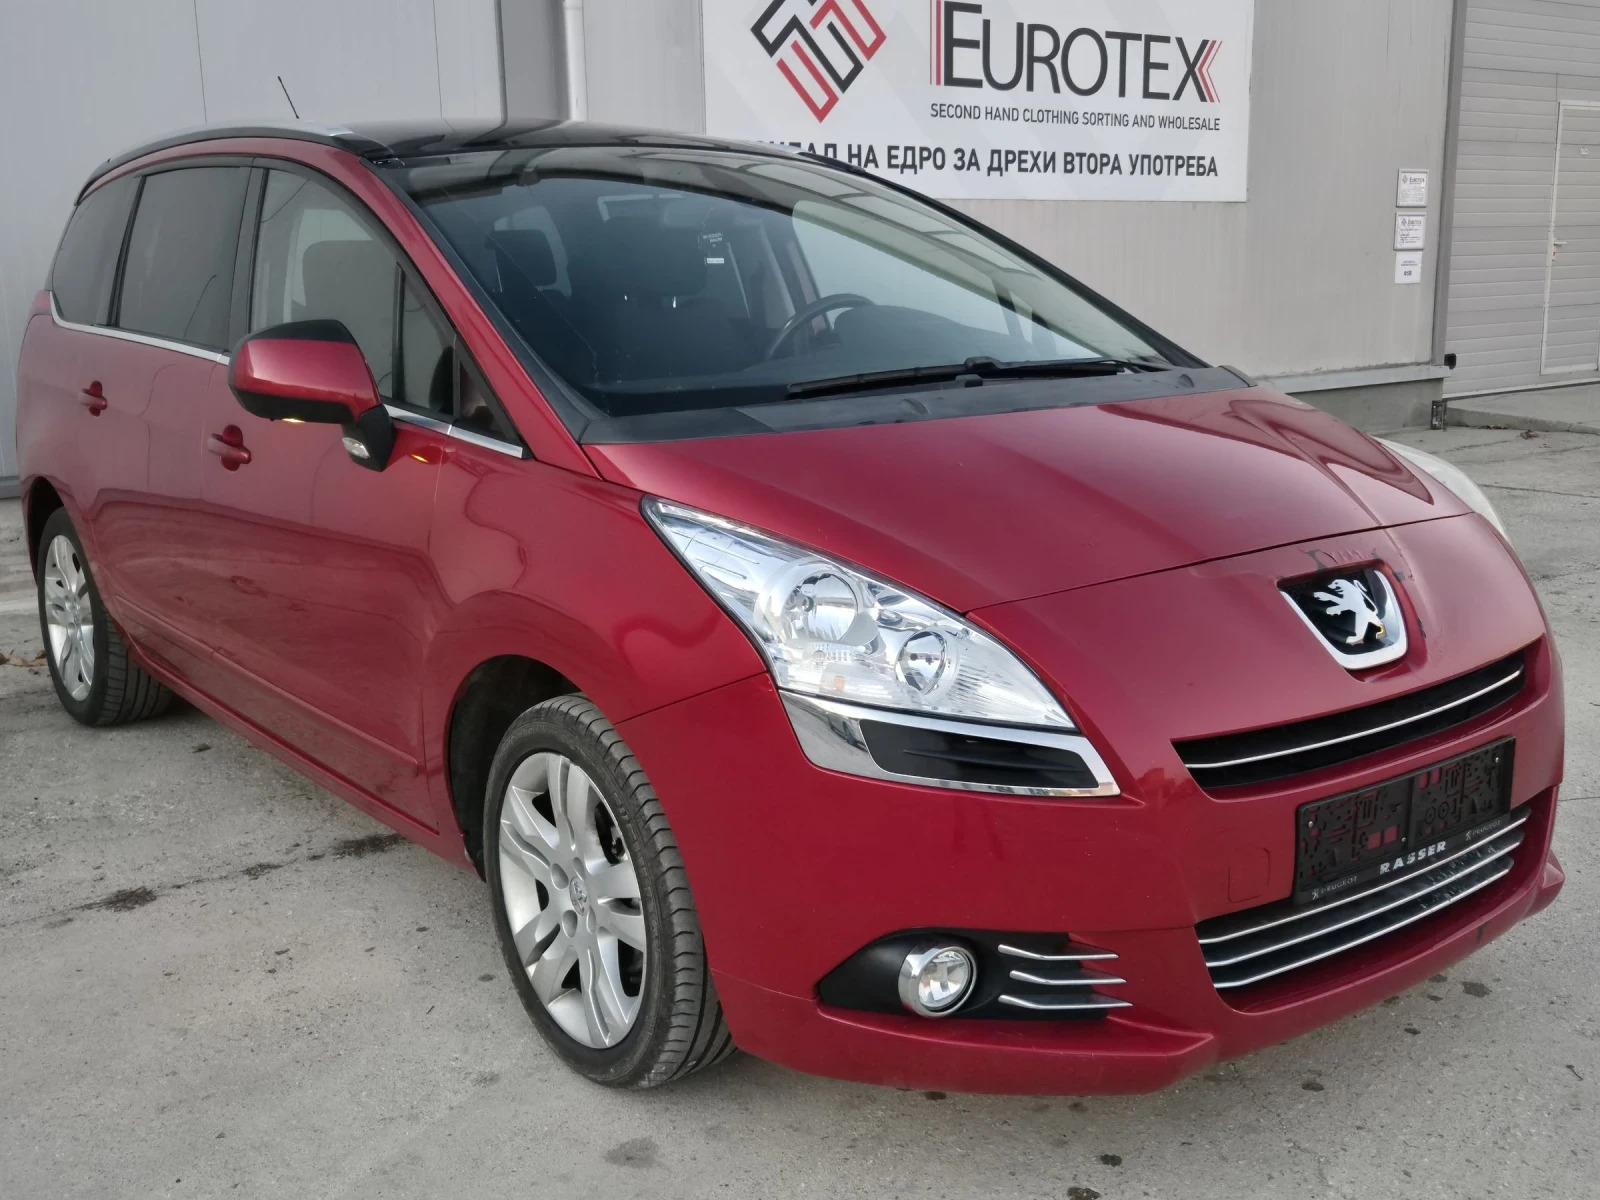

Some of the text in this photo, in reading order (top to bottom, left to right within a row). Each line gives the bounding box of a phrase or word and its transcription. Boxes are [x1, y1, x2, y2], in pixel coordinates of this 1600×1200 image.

[944, 0, 1209, 102] EUROTEX
[930, 102, 1221, 131] SECOND HAND CLOTHING SORTING AND WHOLESALE
[847, 143, 880, 169] НА
[887, 145, 946, 175] ЕДРО
[953, 147, 981, 171] ЗА
[987, 149, 1056, 177] ДРЕХИ
[1063, 152, 1122, 175] ВТОРА
[1128, 153, 1219, 177] УПОТРЕБА
[1379, 840, 1447, 875] RASSER
[1321, 875, 1358, 894] PEUGEOT
